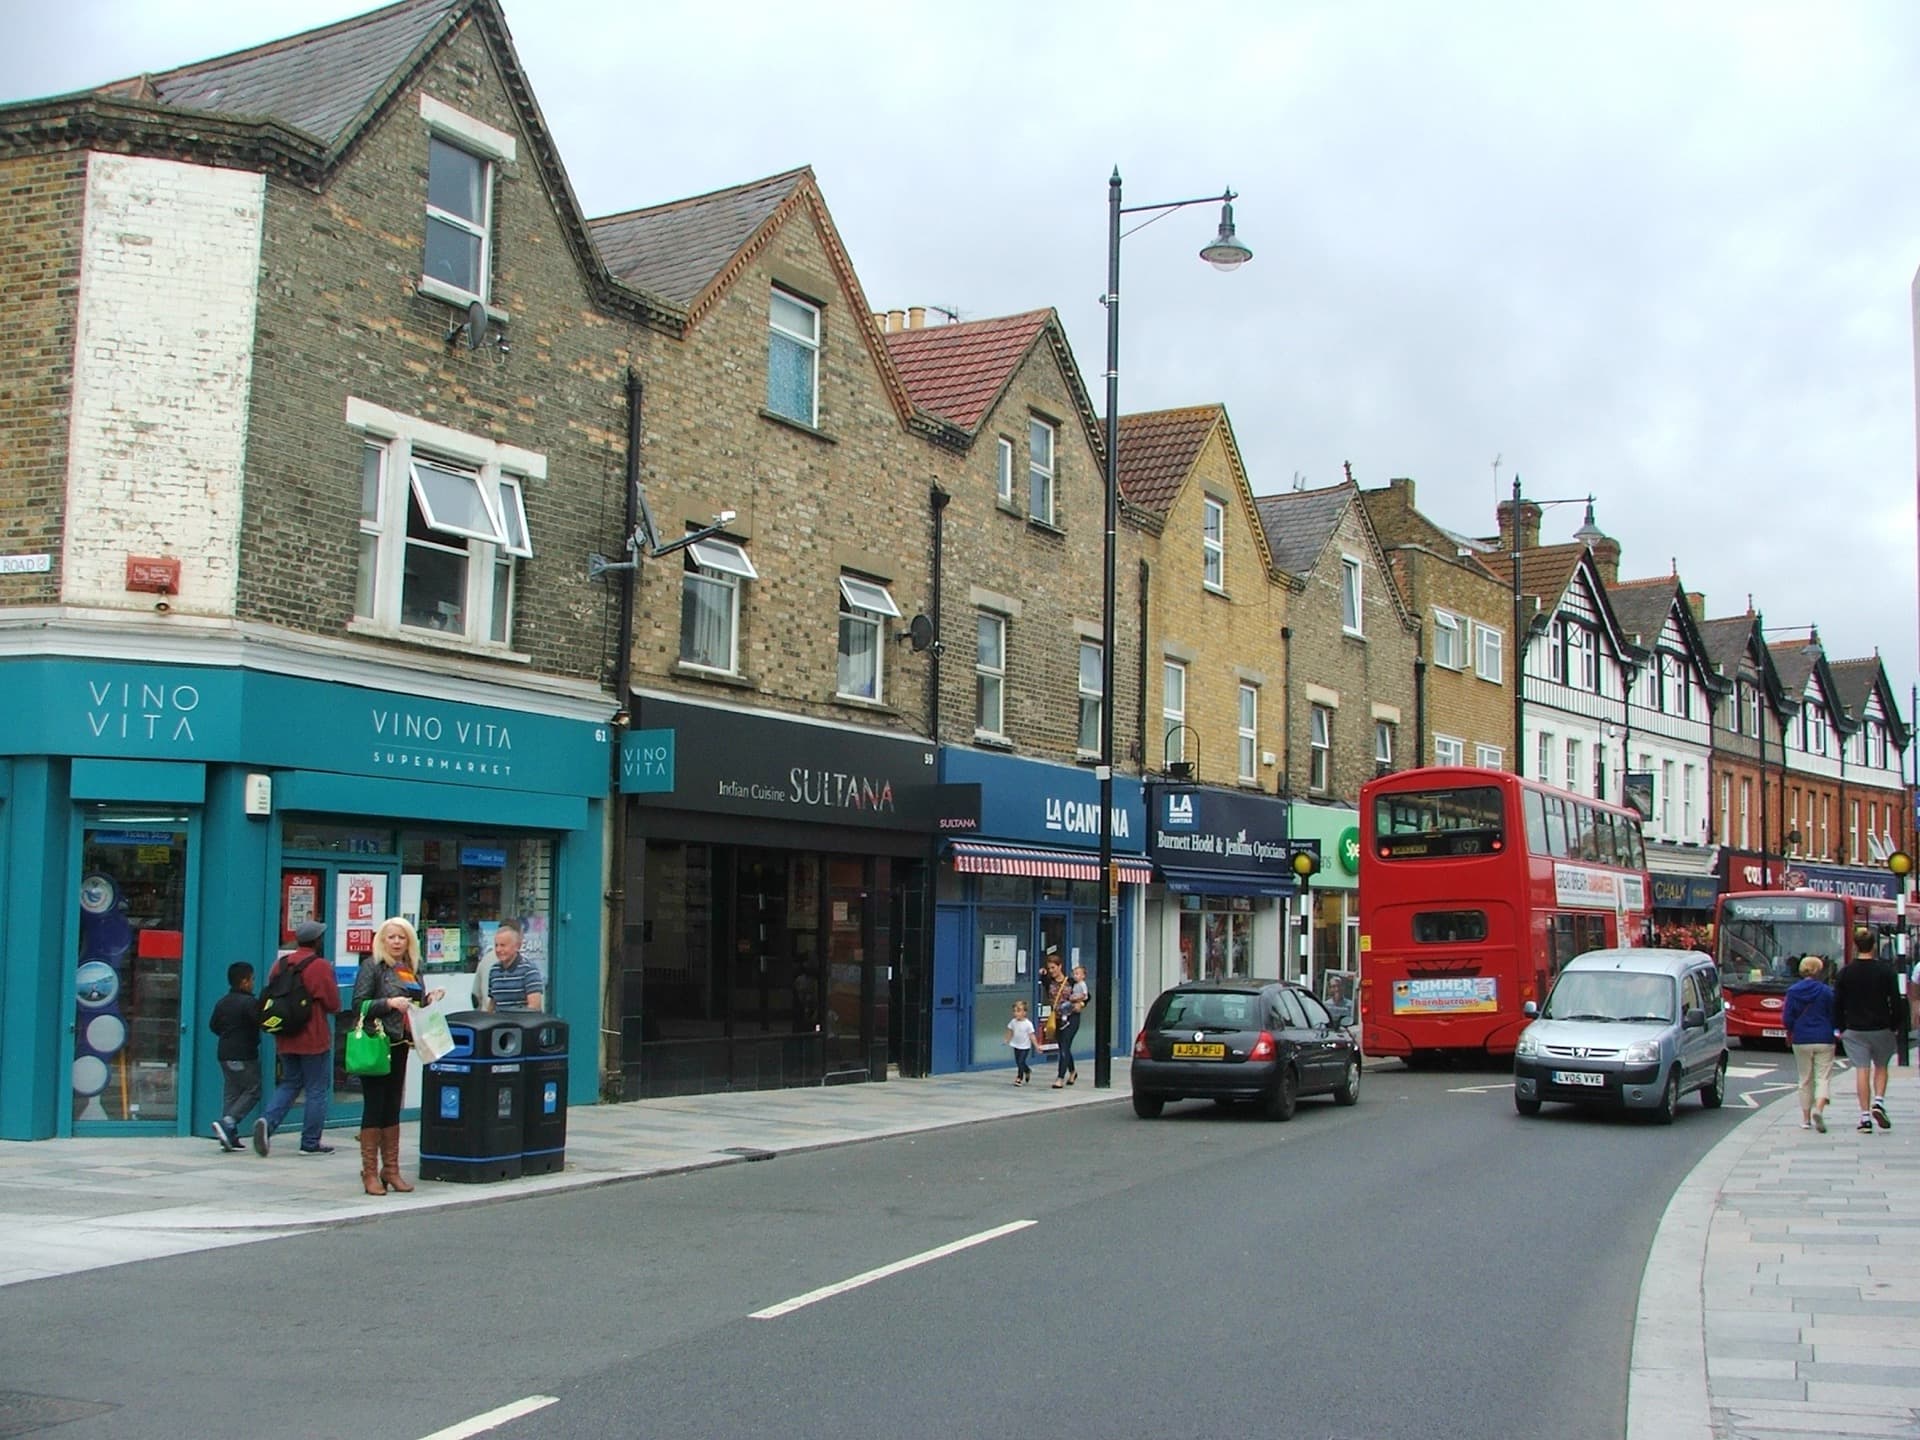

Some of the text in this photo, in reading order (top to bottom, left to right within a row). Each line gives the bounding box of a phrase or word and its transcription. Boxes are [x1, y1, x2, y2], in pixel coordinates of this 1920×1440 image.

[3, 558, 35, 571] ROAD
[89, 681, 199, 711] VINO
[88, 712, 194, 741] VITA
[373, 710, 512, 750] VINO VITA
[595, 729, 606, 742] 61
[624, 746, 668, 761] VINO
[374, 752, 511, 775] SUPERMARKET
[624, 762, 666, 777] VITA
[719, 767, 896, 813] Indian Cuisine SULTANA
[1169, 795, 1192, 811] LA
[939, 818, 977, 829] SULTANA
[1046, 798, 1129, 838] LA CANTNA
[1157, 830, 1287, 862] Burnett Hodd & Jenkins Opticians
[350, 887, 366, 902] 25
[1655, 880, 1686, 899] CHALK
[1808, 879, 1886, 899] STORE TWENTY ONE
[1771, 906, 1797, 915] Station
[1806, 903, 1829, 919] B14
[1411, 979, 1472, 993] SUMMER
[1177, 1045, 1200, 1055] AJ53
[1202, 1045, 1222, 1055] MFU
